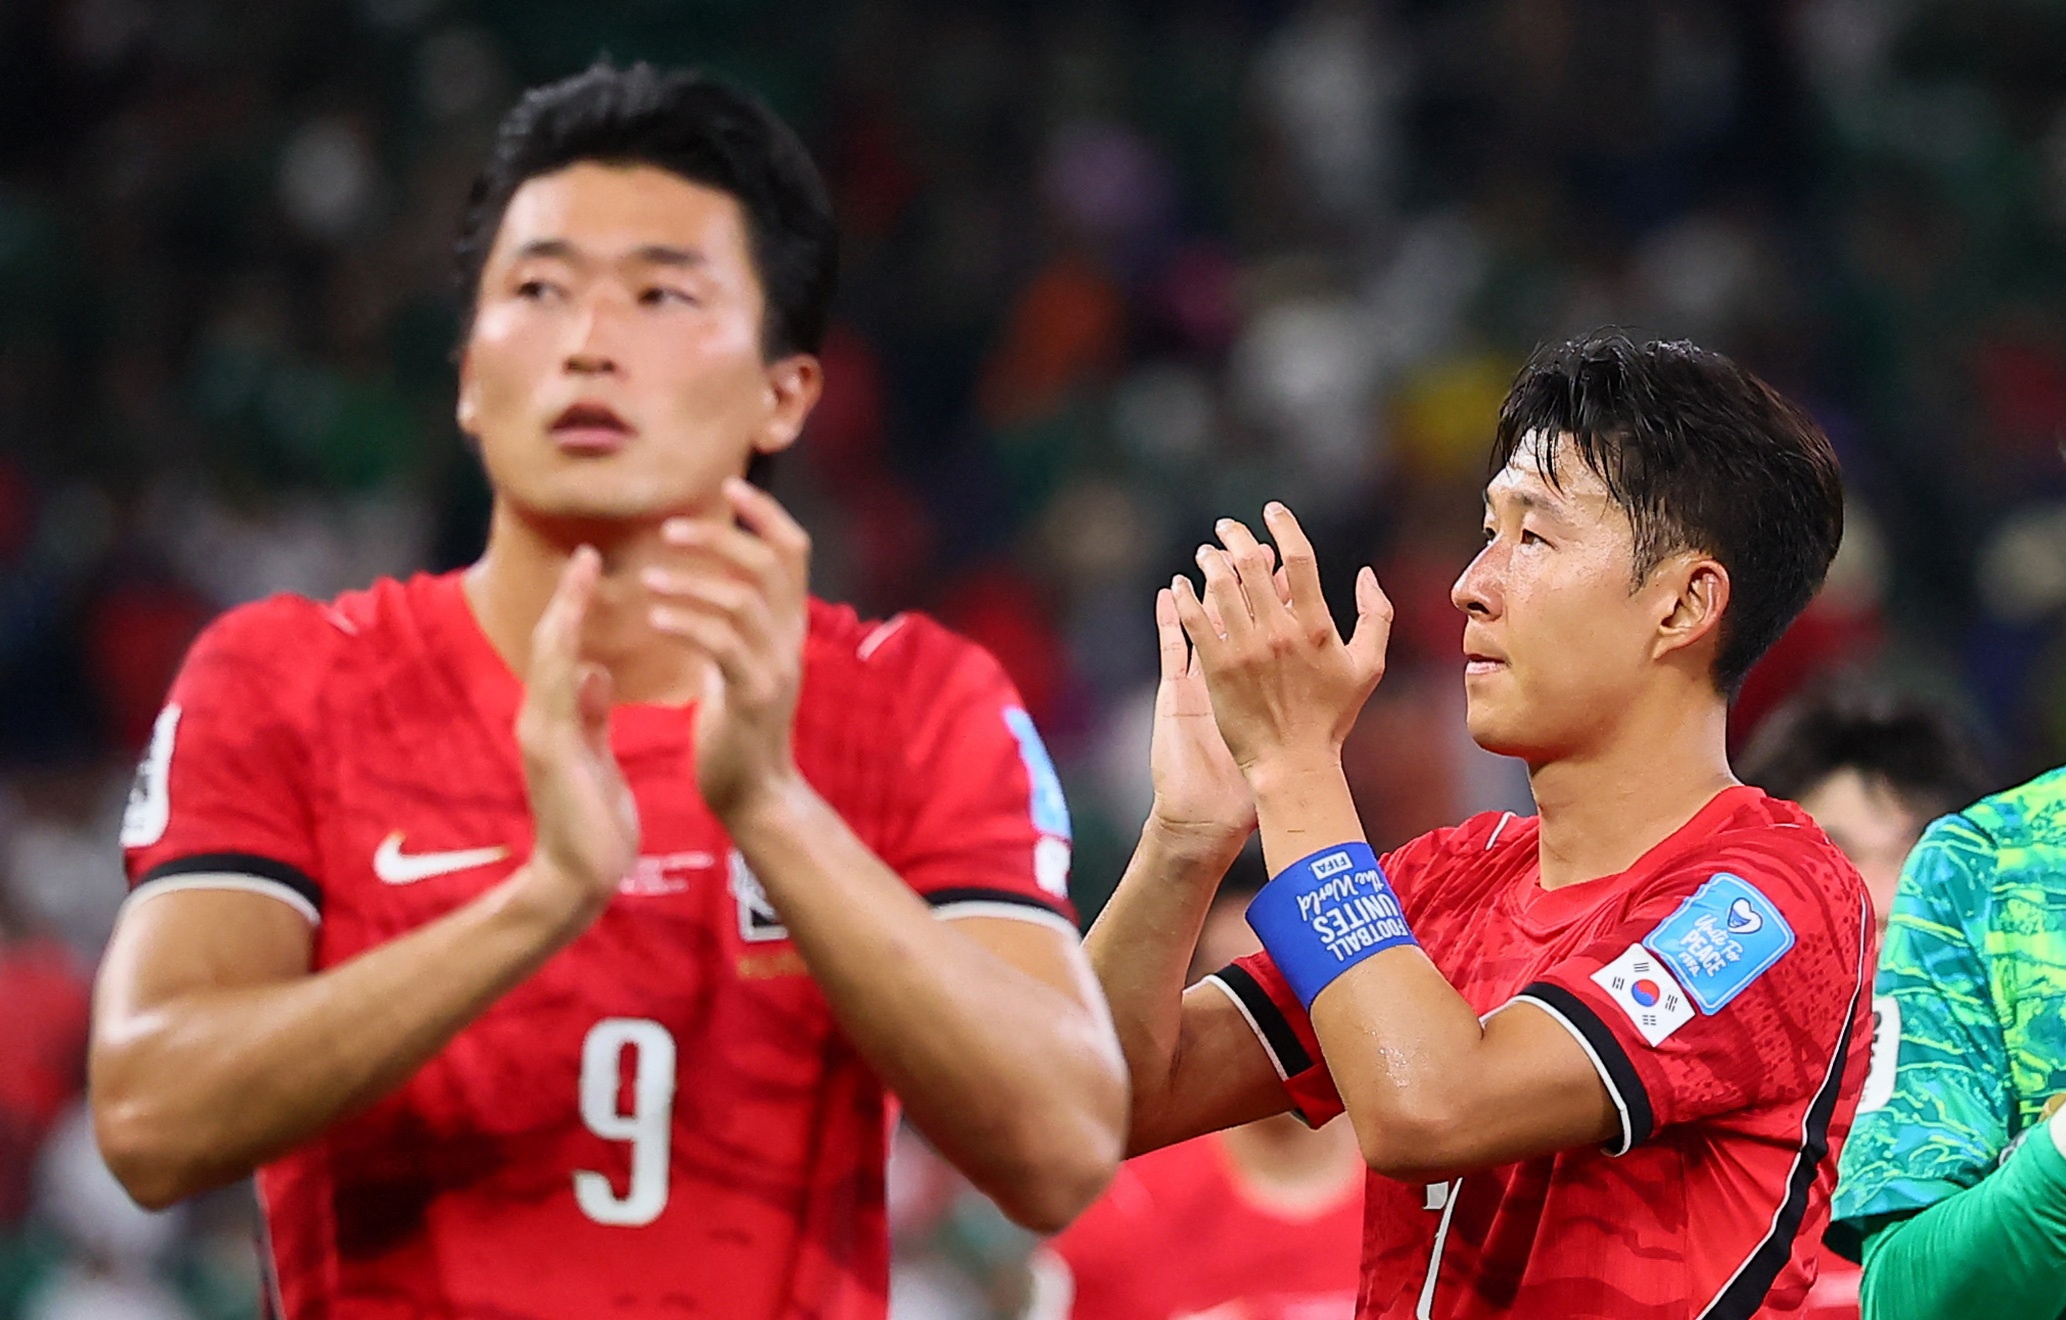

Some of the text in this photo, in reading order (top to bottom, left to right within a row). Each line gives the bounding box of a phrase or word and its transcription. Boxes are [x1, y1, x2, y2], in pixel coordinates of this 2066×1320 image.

[1316, 854, 1348, 874] FIFA
[1296, 869, 1384, 921] the World
[1312, 893, 1399, 944] UNITES
[1326, 918, 1408, 961] FOOTBALL
[1680, 928, 1726, 978] PEACE
[1694, 913, 1743, 963] Unite For
[1678, 951, 1700, 977] FIFA
[572, 1016, 677, 1227] 9
